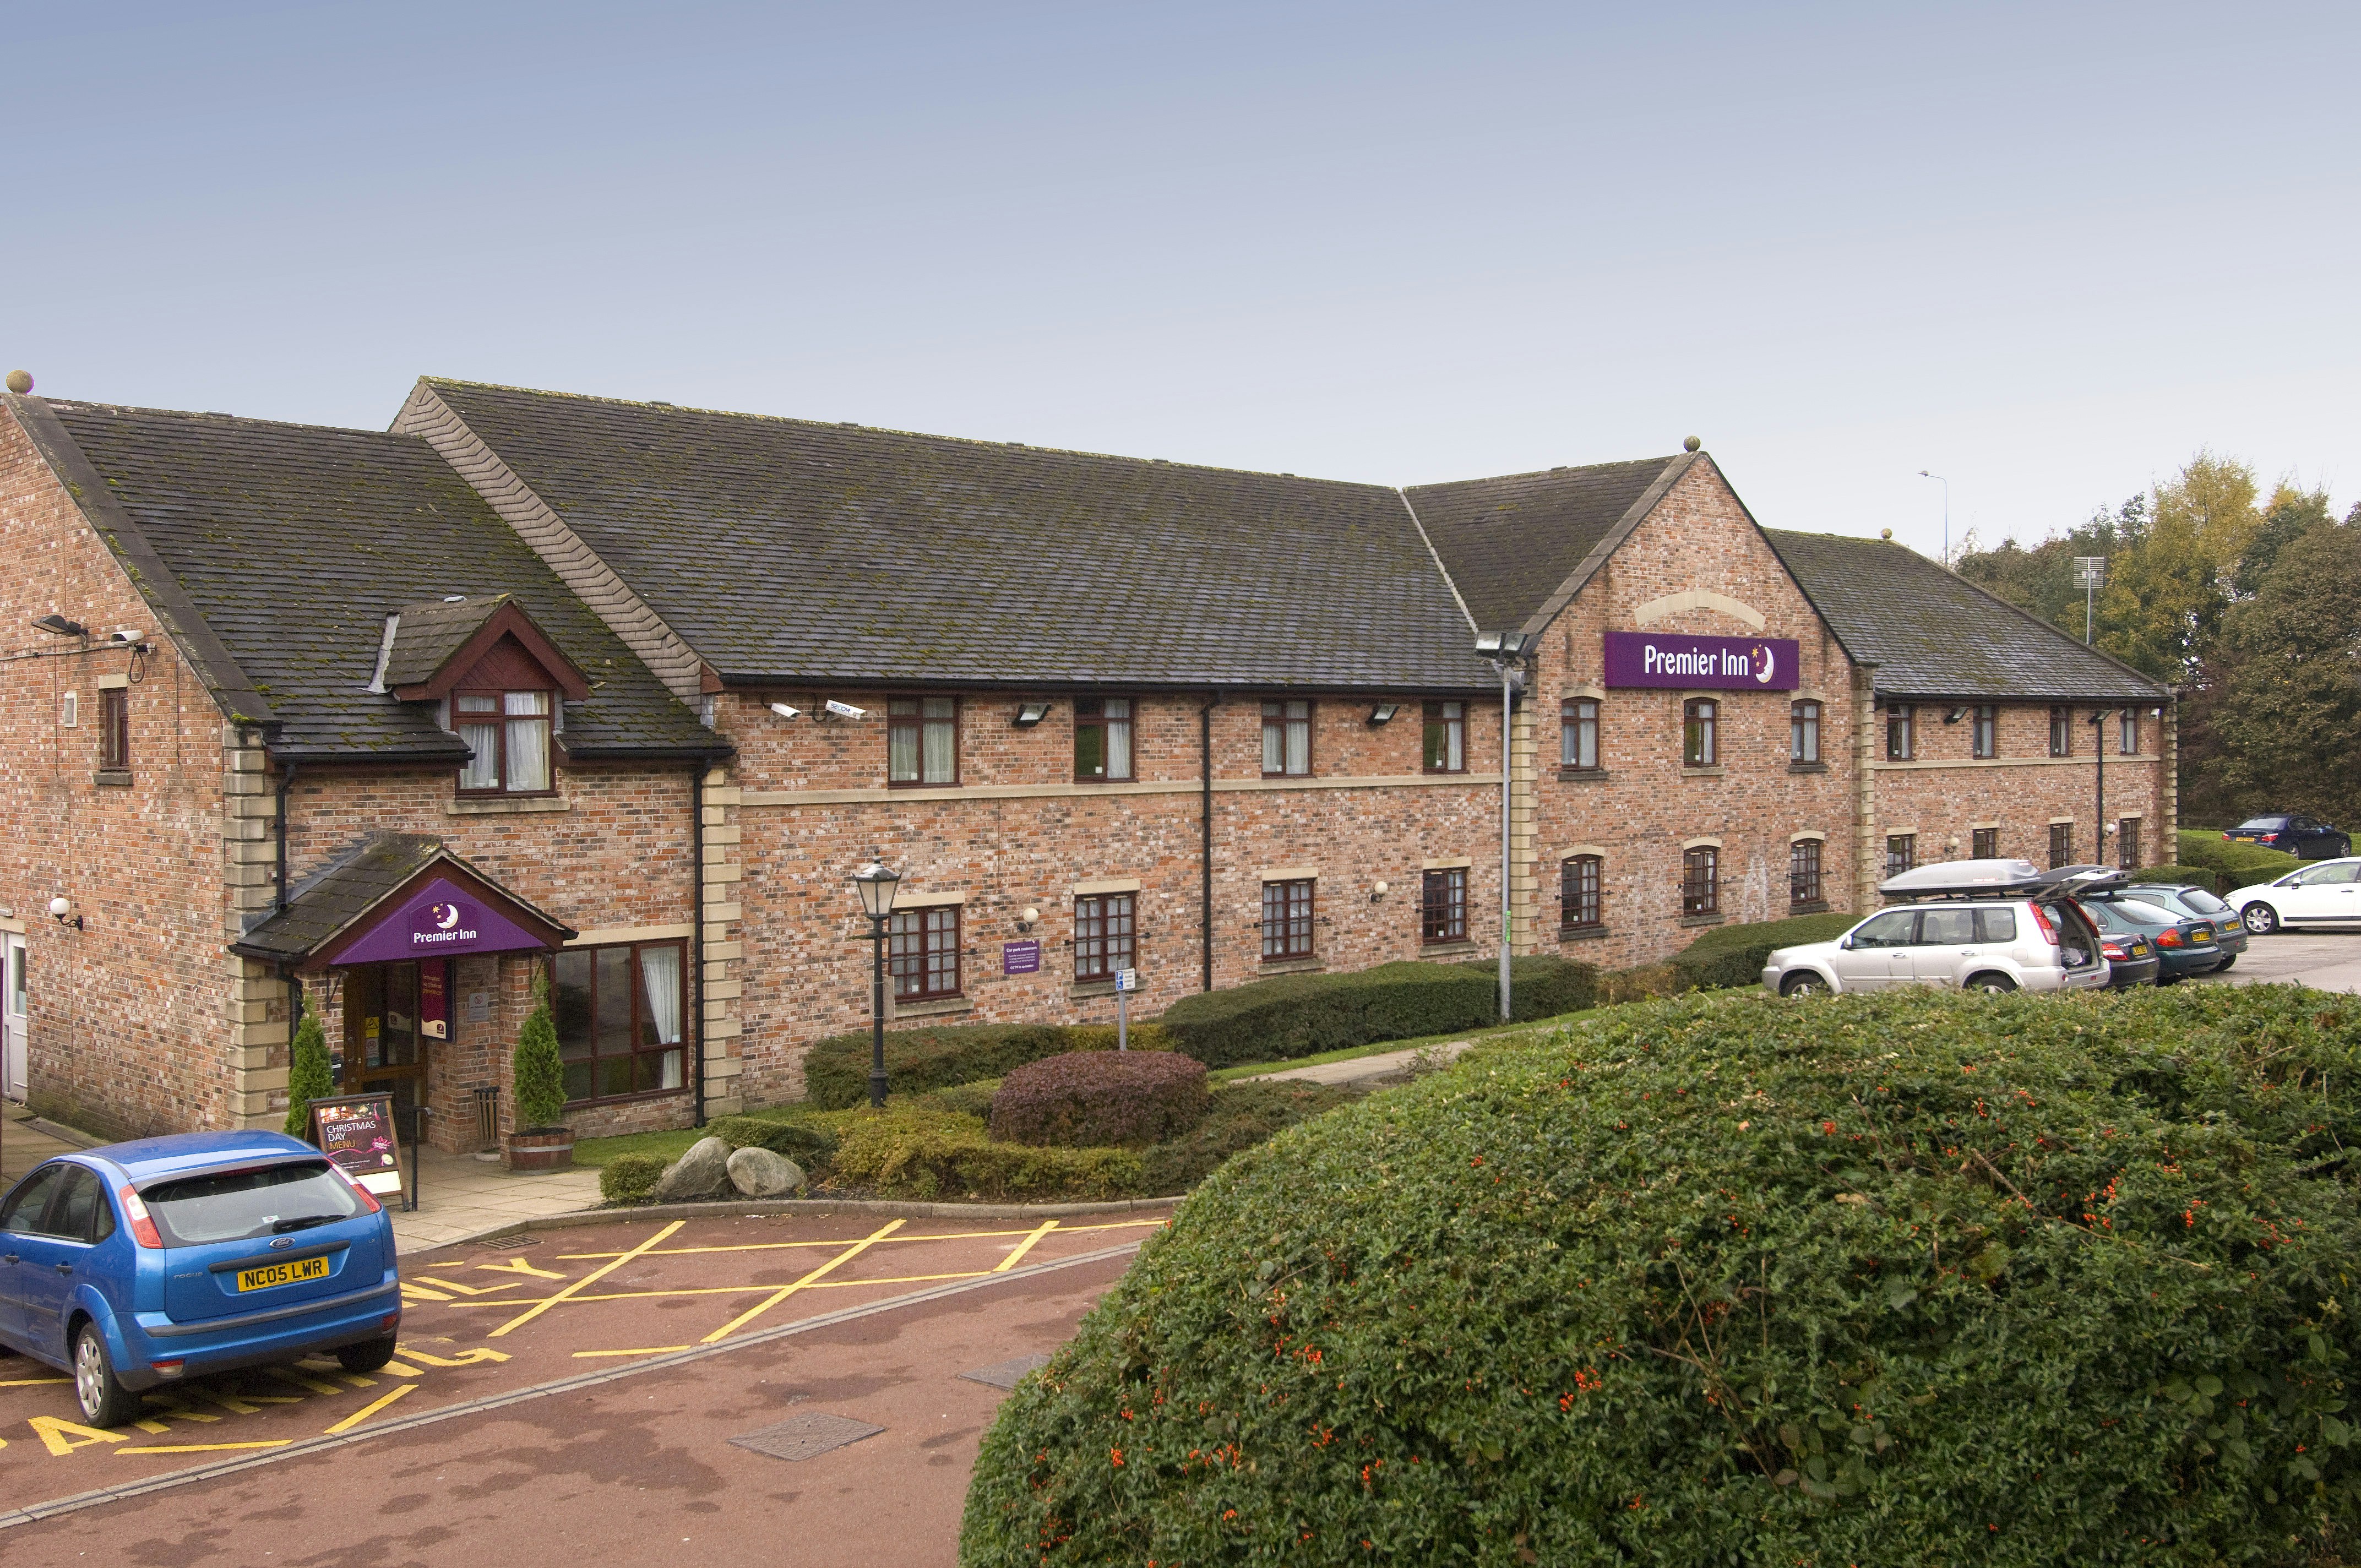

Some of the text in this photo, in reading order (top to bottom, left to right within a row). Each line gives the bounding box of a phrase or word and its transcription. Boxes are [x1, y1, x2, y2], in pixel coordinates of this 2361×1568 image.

[1645, 645, 1749, 676] Premier Inn
[414, 929, 476, 943] Premier Inn
[327, 1120, 376, 1134] CHRISTMAS
[328, 1132, 346, 1142] DAY
[329, 1140, 356, 1150] MENU
[244, 1260, 323, 1288] NC05 LWR
